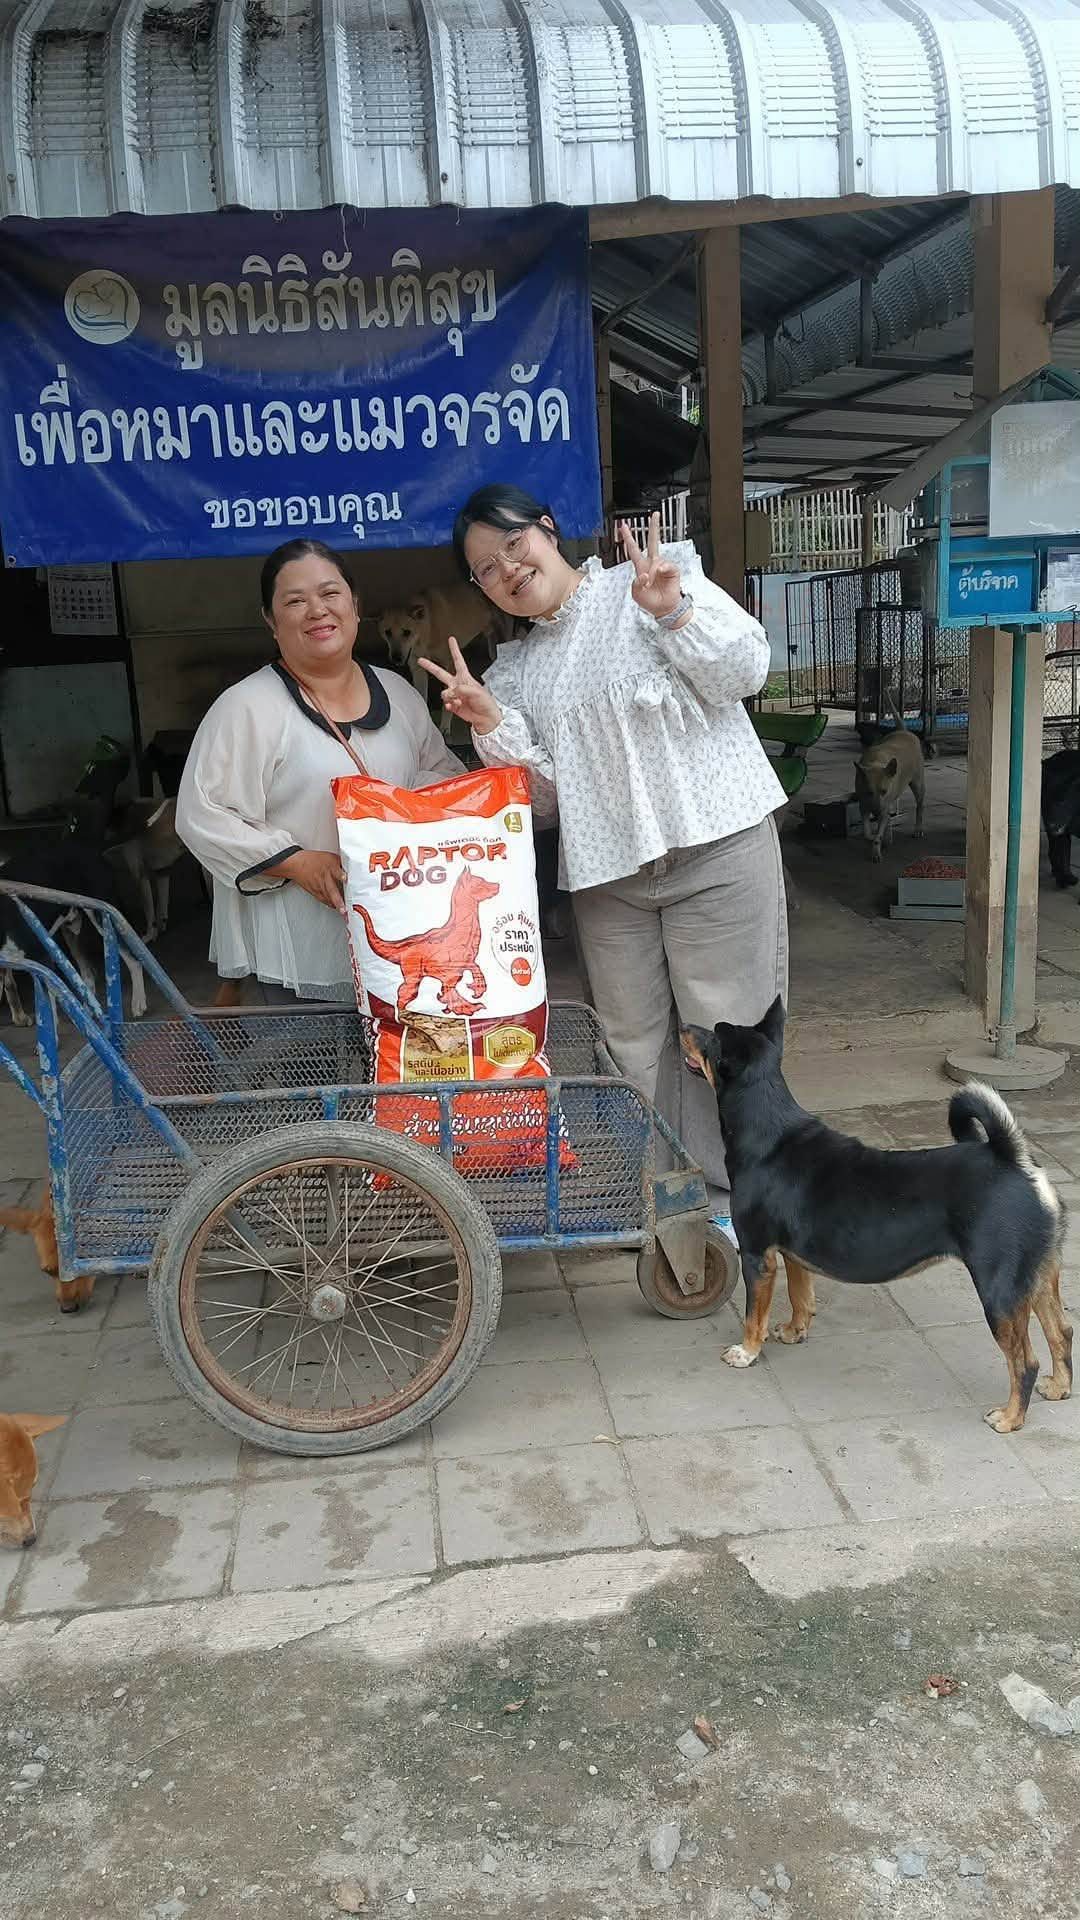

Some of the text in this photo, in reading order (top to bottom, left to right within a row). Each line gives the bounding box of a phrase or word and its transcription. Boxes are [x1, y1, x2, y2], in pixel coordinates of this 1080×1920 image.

[163, 248, 498, 370] มูลนิธิสันติสุข
[14, 363, 571, 467] เพื่อหมาและแมวจรจัด
[203, 488, 403, 540] ขอขอบคุณ
[958, 566, 1019, 600] ตู้บริจาค
[368, 842, 508, 873] RAPTOR
[380, 865, 448, 892] DOG
[499, 940, 535, 953] ประหยัด
[504, 929, 529, 941] ราคา
